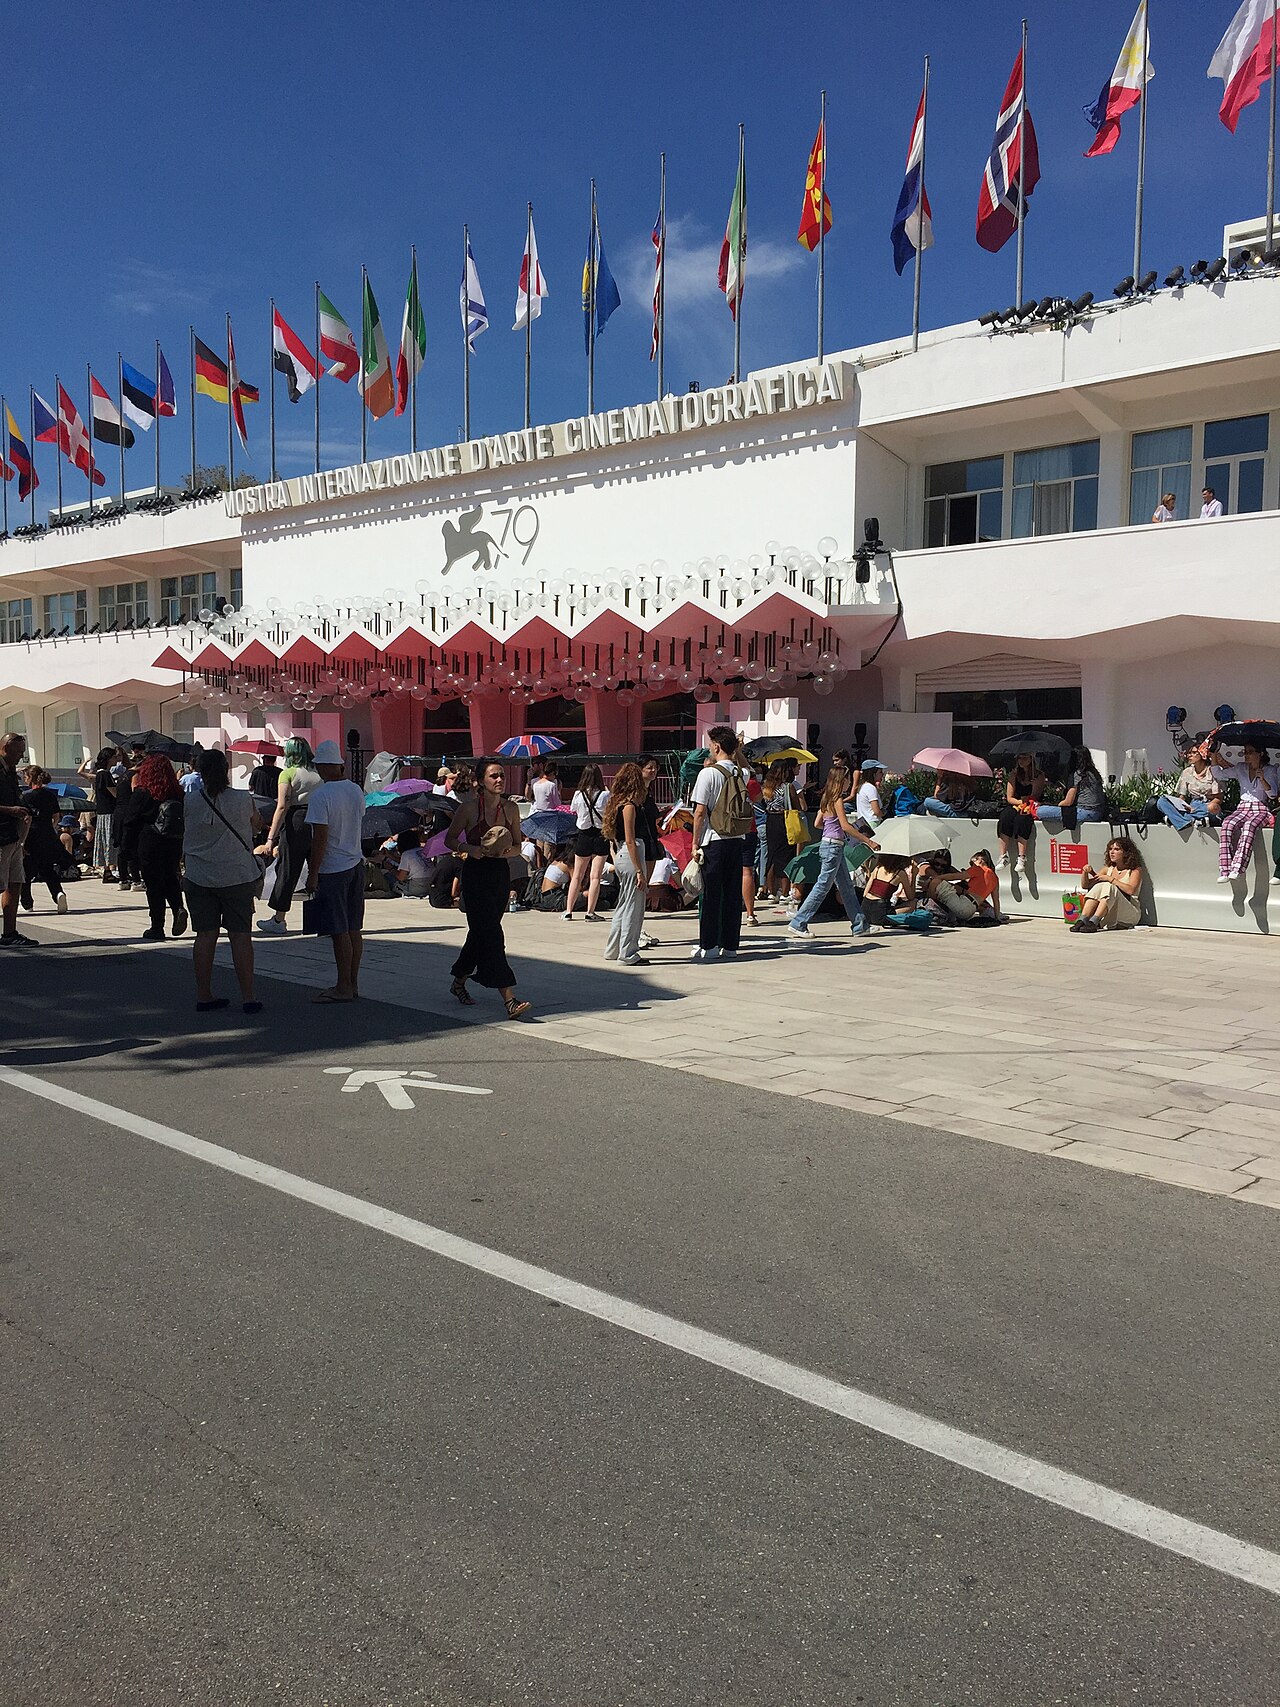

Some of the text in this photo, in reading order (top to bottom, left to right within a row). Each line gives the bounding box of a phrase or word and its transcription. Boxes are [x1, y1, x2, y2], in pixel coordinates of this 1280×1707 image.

[222, 363, 844, 518] MOSTRA INTERNAZIONALE D'ARTE CINEMATOGRAFICA
[491, 504, 540, 569] 79
